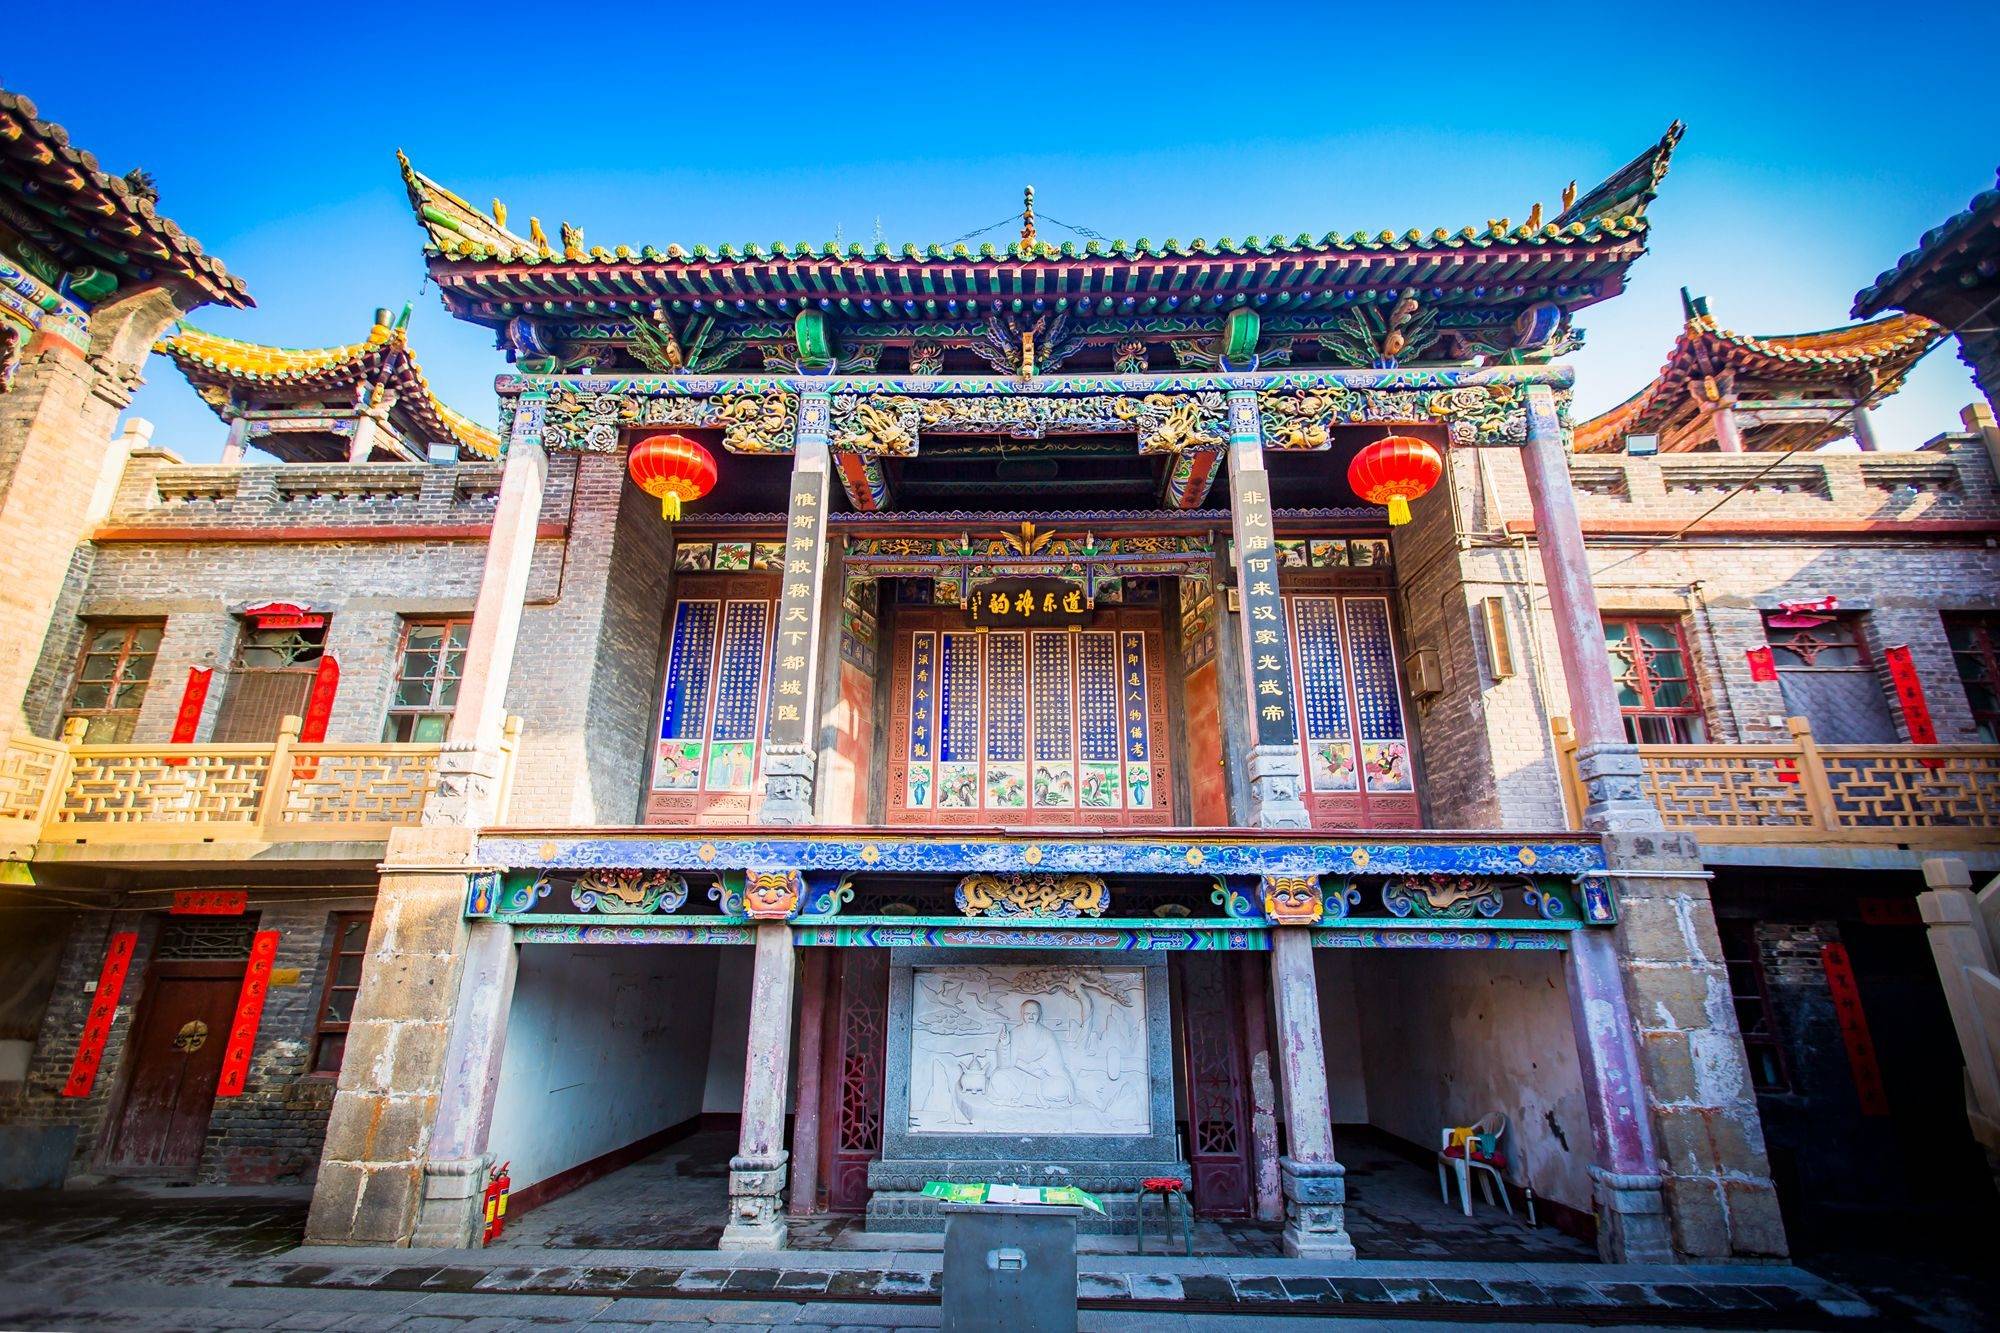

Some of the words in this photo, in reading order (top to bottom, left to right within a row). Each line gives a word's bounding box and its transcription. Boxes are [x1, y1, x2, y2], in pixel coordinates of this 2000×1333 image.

[778, 492, 816, 721] 惟斯神敢称天下都城隍
[1242, 490, 1285, 722] 非此庙何来汉家光武帝
